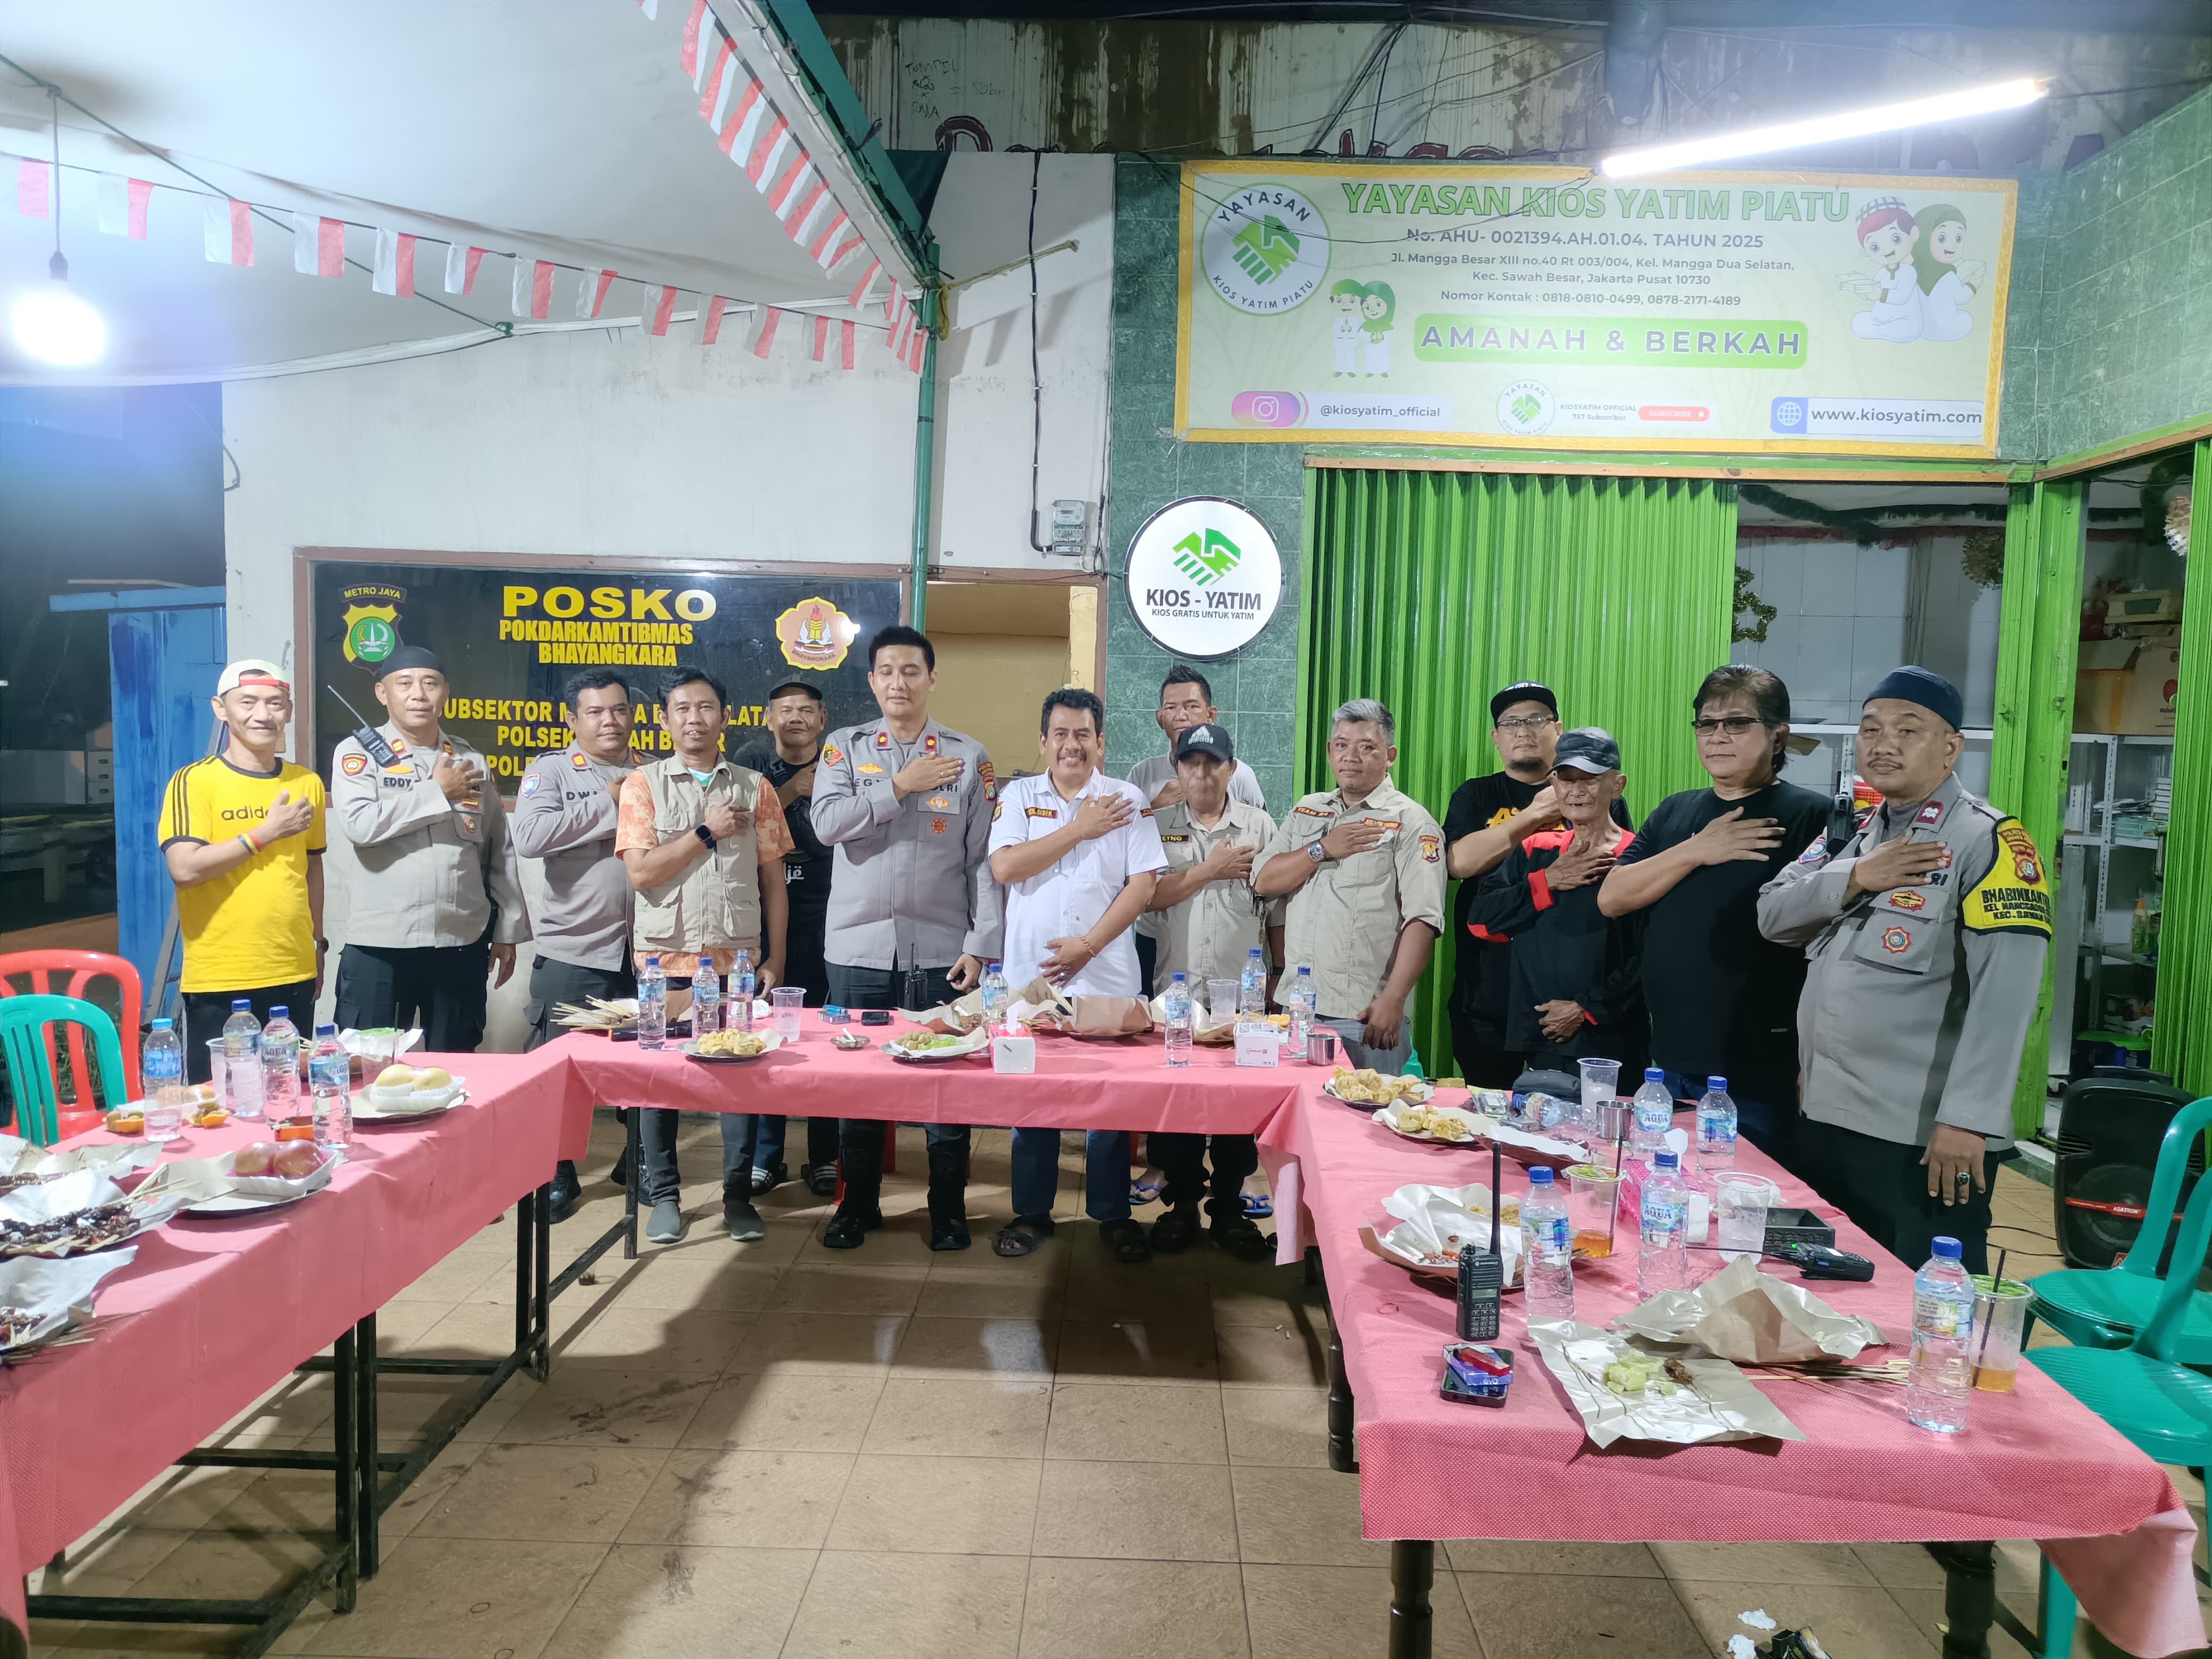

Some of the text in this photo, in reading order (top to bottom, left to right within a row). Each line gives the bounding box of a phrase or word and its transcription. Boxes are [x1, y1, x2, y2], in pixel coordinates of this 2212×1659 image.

[1218, 191, 1310, 222] YAYASAN
[1342, 183, 1850, 222] YAYASAN KIOS YATIM PIATU
[1407, 228, 1436, 243] No.
[1440, 230, 1486, 244] AHU-
[1654, 233, 1717, 247] TAHUN
[1722, 234, 1764, 248] 2025
[1390, 253, 1795, 271] Jl. Mangga Besar XIII no.40 Rt 003/004, Kel. Mangga Dua Selatan,
[1472, 271, 1711, 286] Kec. Sawah Besar, Jakarta Pusat 10730
[1213, 275, 1313, 309] KIOS YATIM PIATU
[1440, 291, 1484, 301] Nomor
[1487, 291, 1532, 302] Kontak
[1542, 292, 1644, 305] 0818-0810-0499,
[1647, 295, 1741, 306] 0878-2171-4189
[1421, 325, 1800, 356] AMANAH & BERKAH
[1504, 383, 1547, 398] YAYASAN
[1320, 405, 1440, 418] @kiosyatim_official
[1648, 409, 1692, 418] SUBSCRIBE
[1811, 408, 1983, 425] www.kiosyatim.com
[343, 586, 400, 599] METRO JAYA
[1146, 589, 1191, 607] KIOS
[1205, 591, 1261, 610] YATIM
[503, 585, 717, 622] POSKO
[1152, 608, 1254, 620] KIOS GRATIS UNTUK YATIM
[499, 619, 694, 646] POKDARKAMTIBMAS
[538, 642, 678, 667] BHAYANGKARA
[439, 698, 552, 722] UBSEKTOR
[497, 725, 575, 749] POLSEK
[221, 805, 269, 820] adid
[1297, 808, 1317, 816] TEAM
[1644, 1113, 1668, 1124] AQUA
[1644, 1205, 1672, 1220] AQUA
